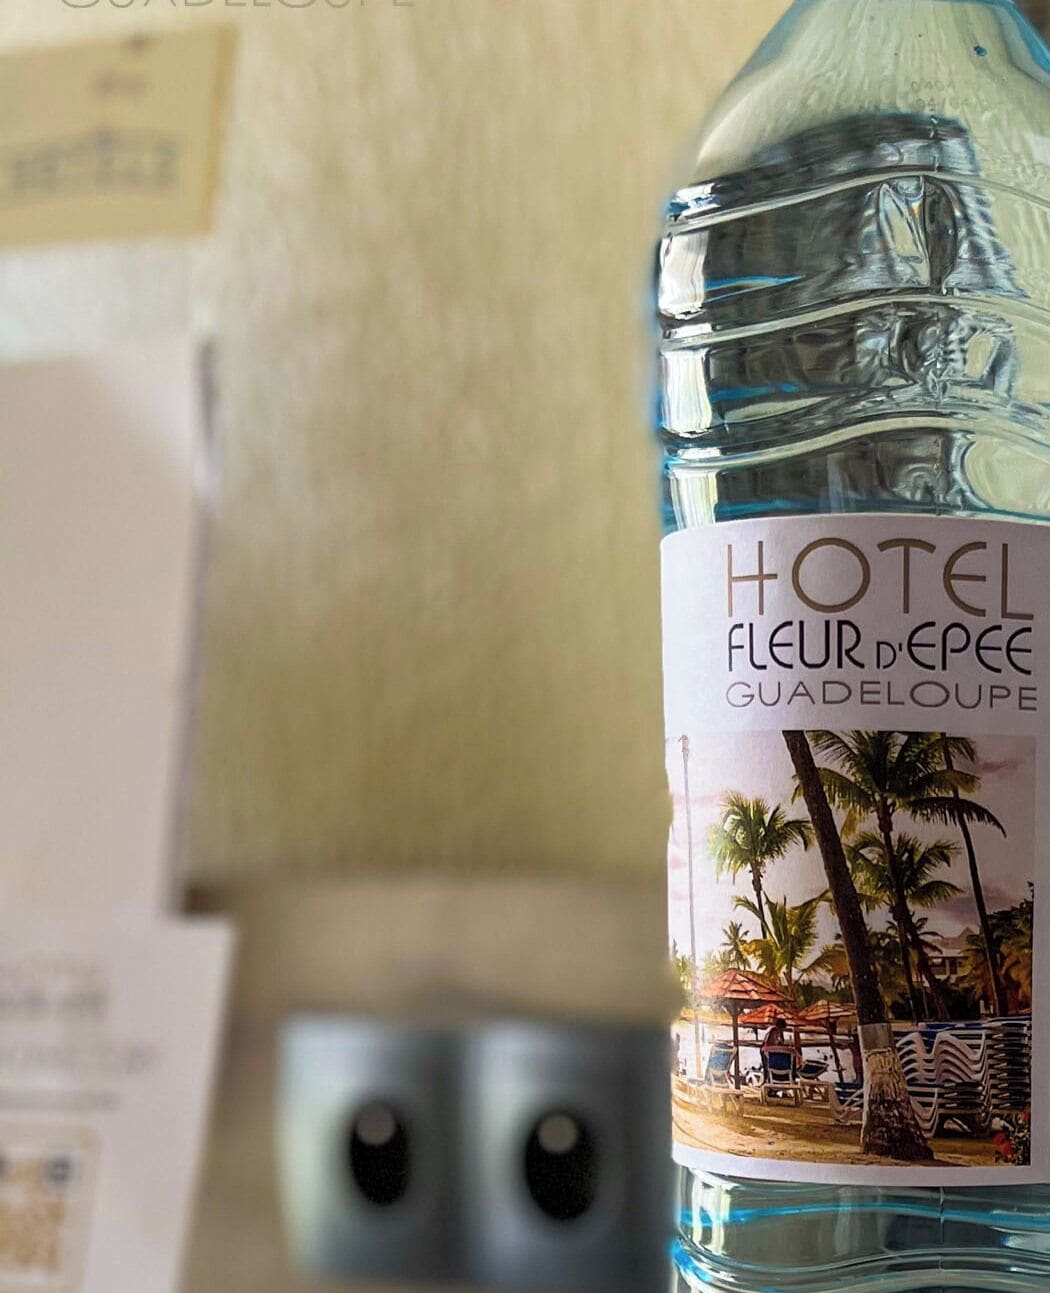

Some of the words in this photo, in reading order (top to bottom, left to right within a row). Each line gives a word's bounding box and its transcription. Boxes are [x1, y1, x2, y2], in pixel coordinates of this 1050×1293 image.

[728, 537, 1034, 620] HOTEL
[728, 620, 865, 671] FLEUR
[726, 681, 1037, 711] GUADELOUPE
